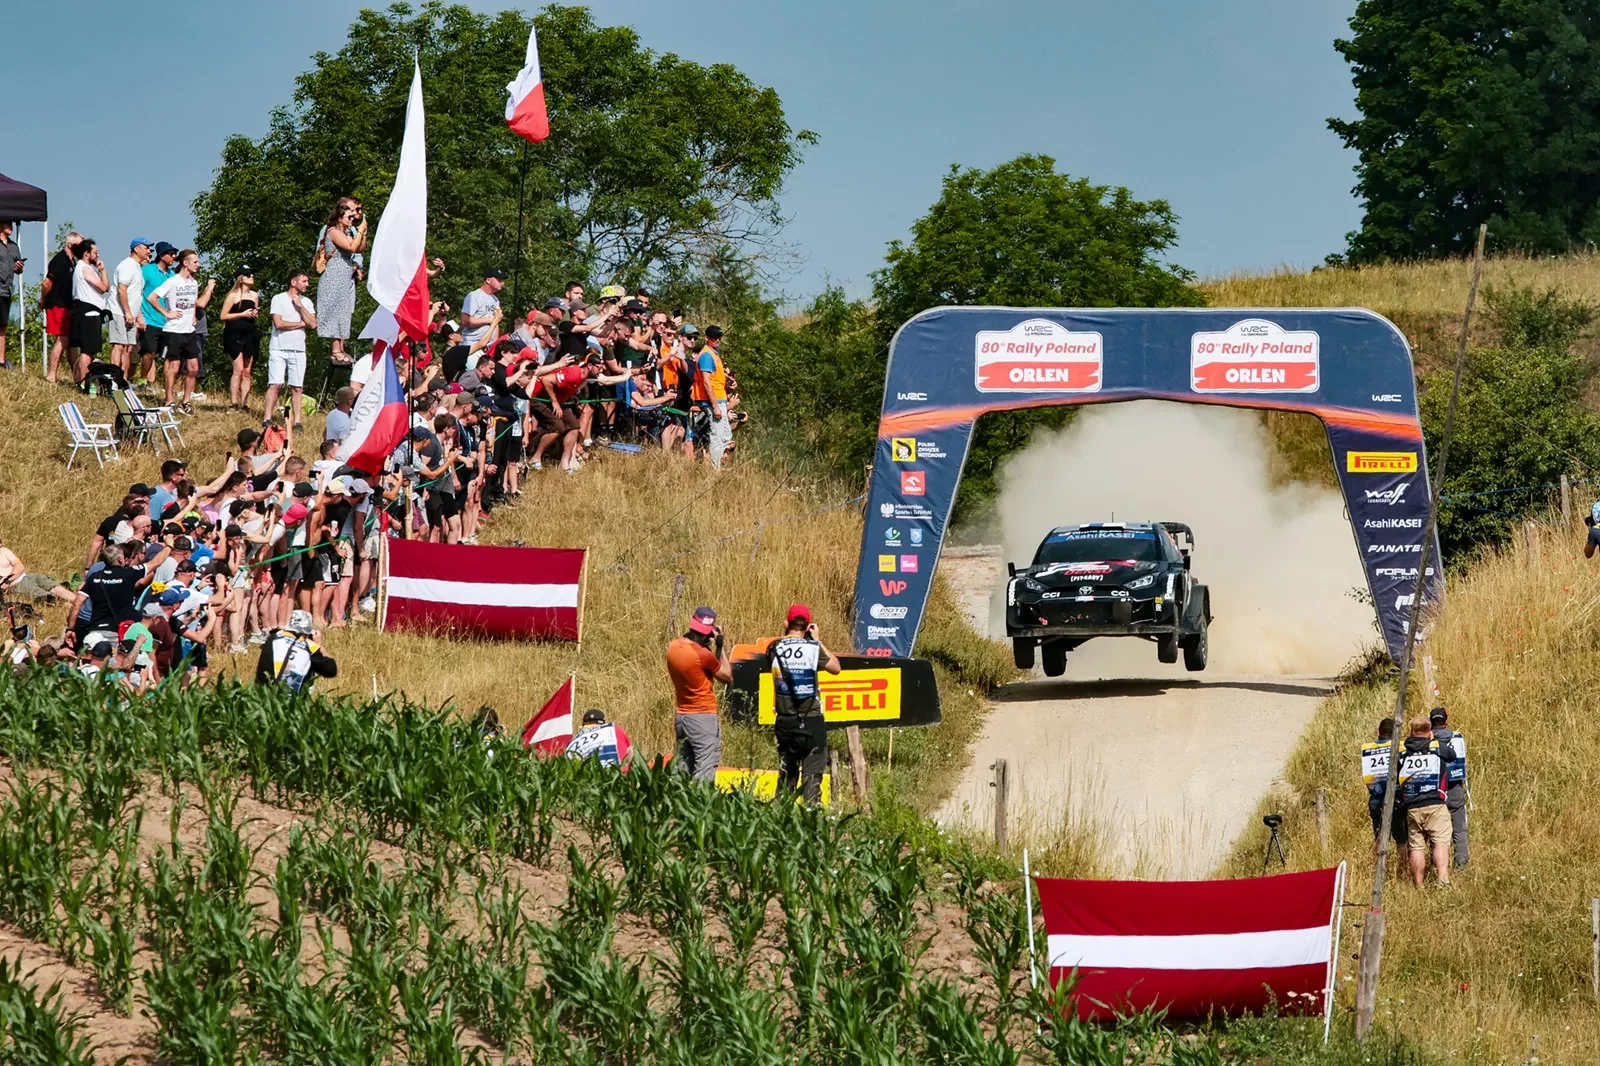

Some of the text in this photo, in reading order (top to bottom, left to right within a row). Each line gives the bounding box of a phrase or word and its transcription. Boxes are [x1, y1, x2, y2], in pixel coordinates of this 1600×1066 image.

[1024, 325, 1053, 333] WRC
[1241, 325, 1269, 333] WRC
[1006, 342, 1044, 357] Rally
[1046, 342, 1097, 354] Poland
[1221, 342, 1259, 357] Rally
[1261, 341, 1314, 354] Poland
[1008, 367, 1069, 383] ORLEN
[1225, 368, 1286, 383] ORLEN
[897, 392, 928, 401] WRC
[1372, 394, 1402, 402] WRC
[1354, 455, 1412, 470] PIRELLI
[1363, 518, 1422, 528] AsahiKASEI
[1367, 544, 1424, 553] FANATE
[879, 579, 907, 597] WP
[1406, 758, 1429, 769] 201
